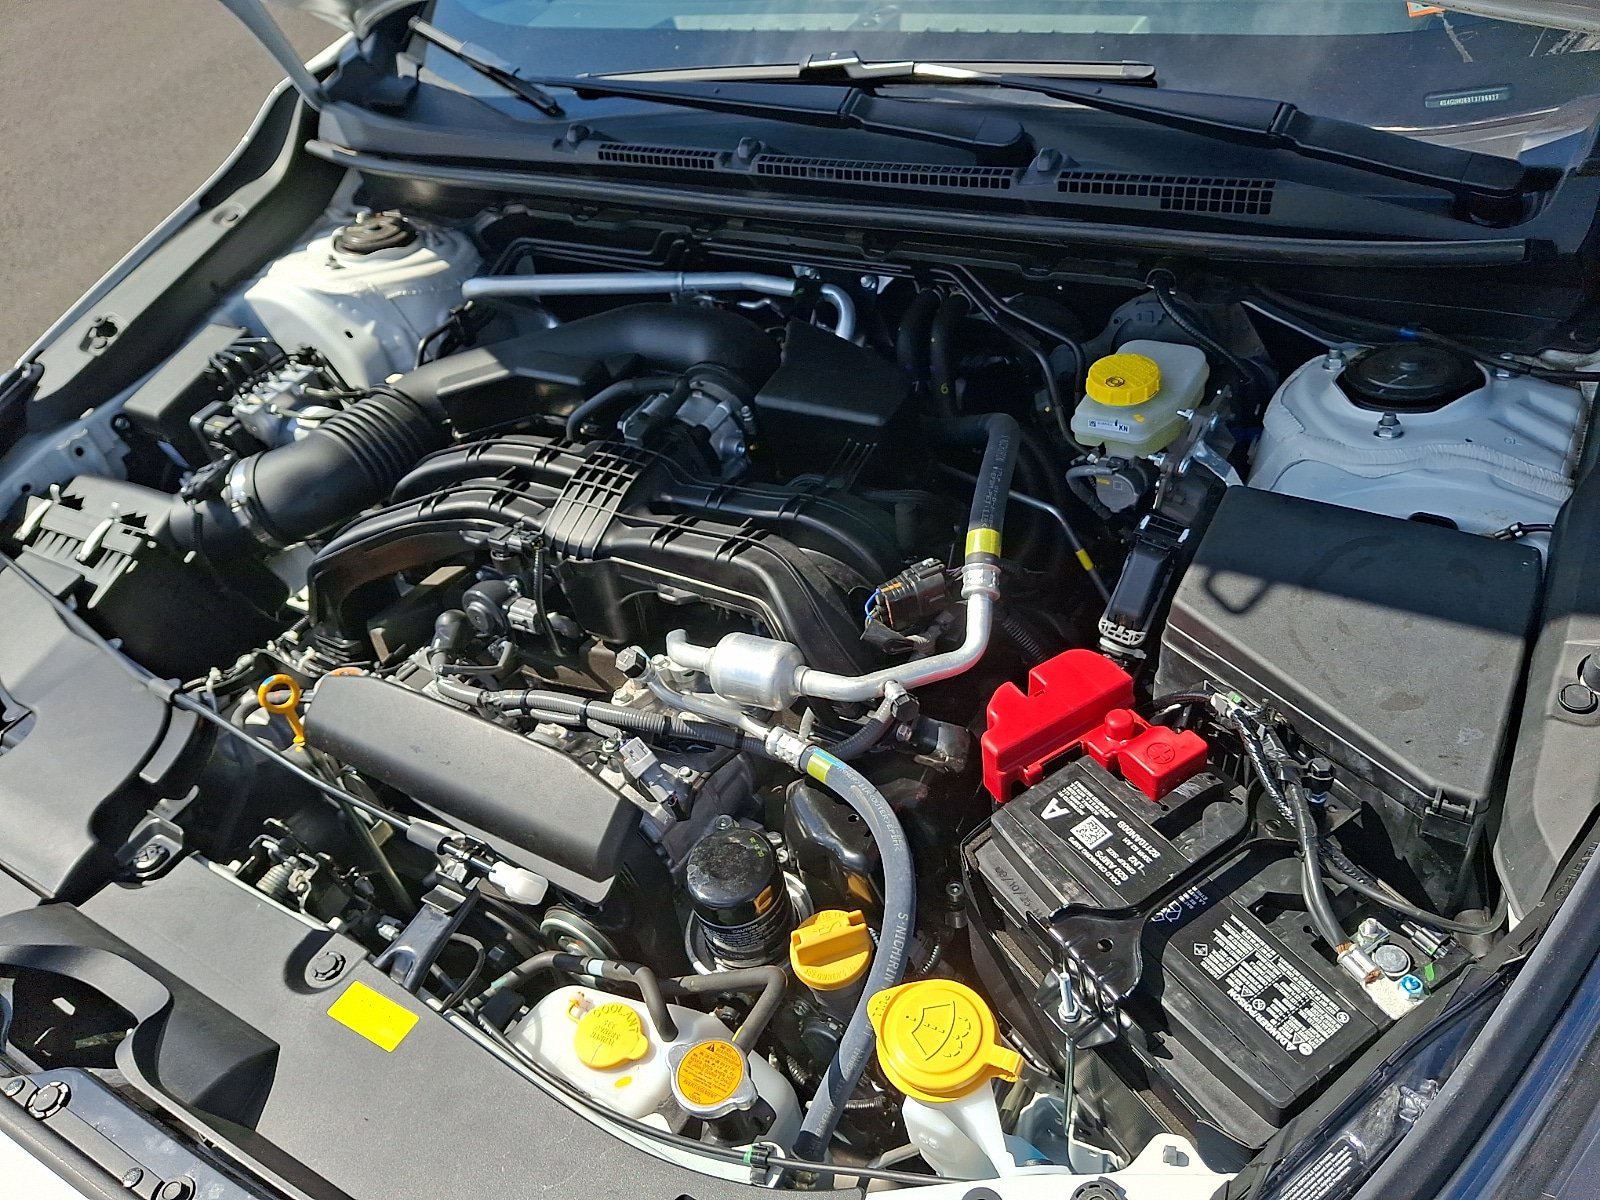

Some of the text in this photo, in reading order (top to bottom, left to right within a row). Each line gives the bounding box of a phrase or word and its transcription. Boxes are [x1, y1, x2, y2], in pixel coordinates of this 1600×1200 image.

[1041, 797, 1071, 820] A
[1067, 835, 1121, 885] COLD CRANKING AMPS
[1093, 849, 1129, 880] 620 AMPS
[1105, 846, 1137, 874] GROUP SIZE
[732, 924, 758, 933] CAUTION
[592, 1003, 639, 1034] COOLANT
[1226, 987, 1289, 1045] DANGER/POISON
